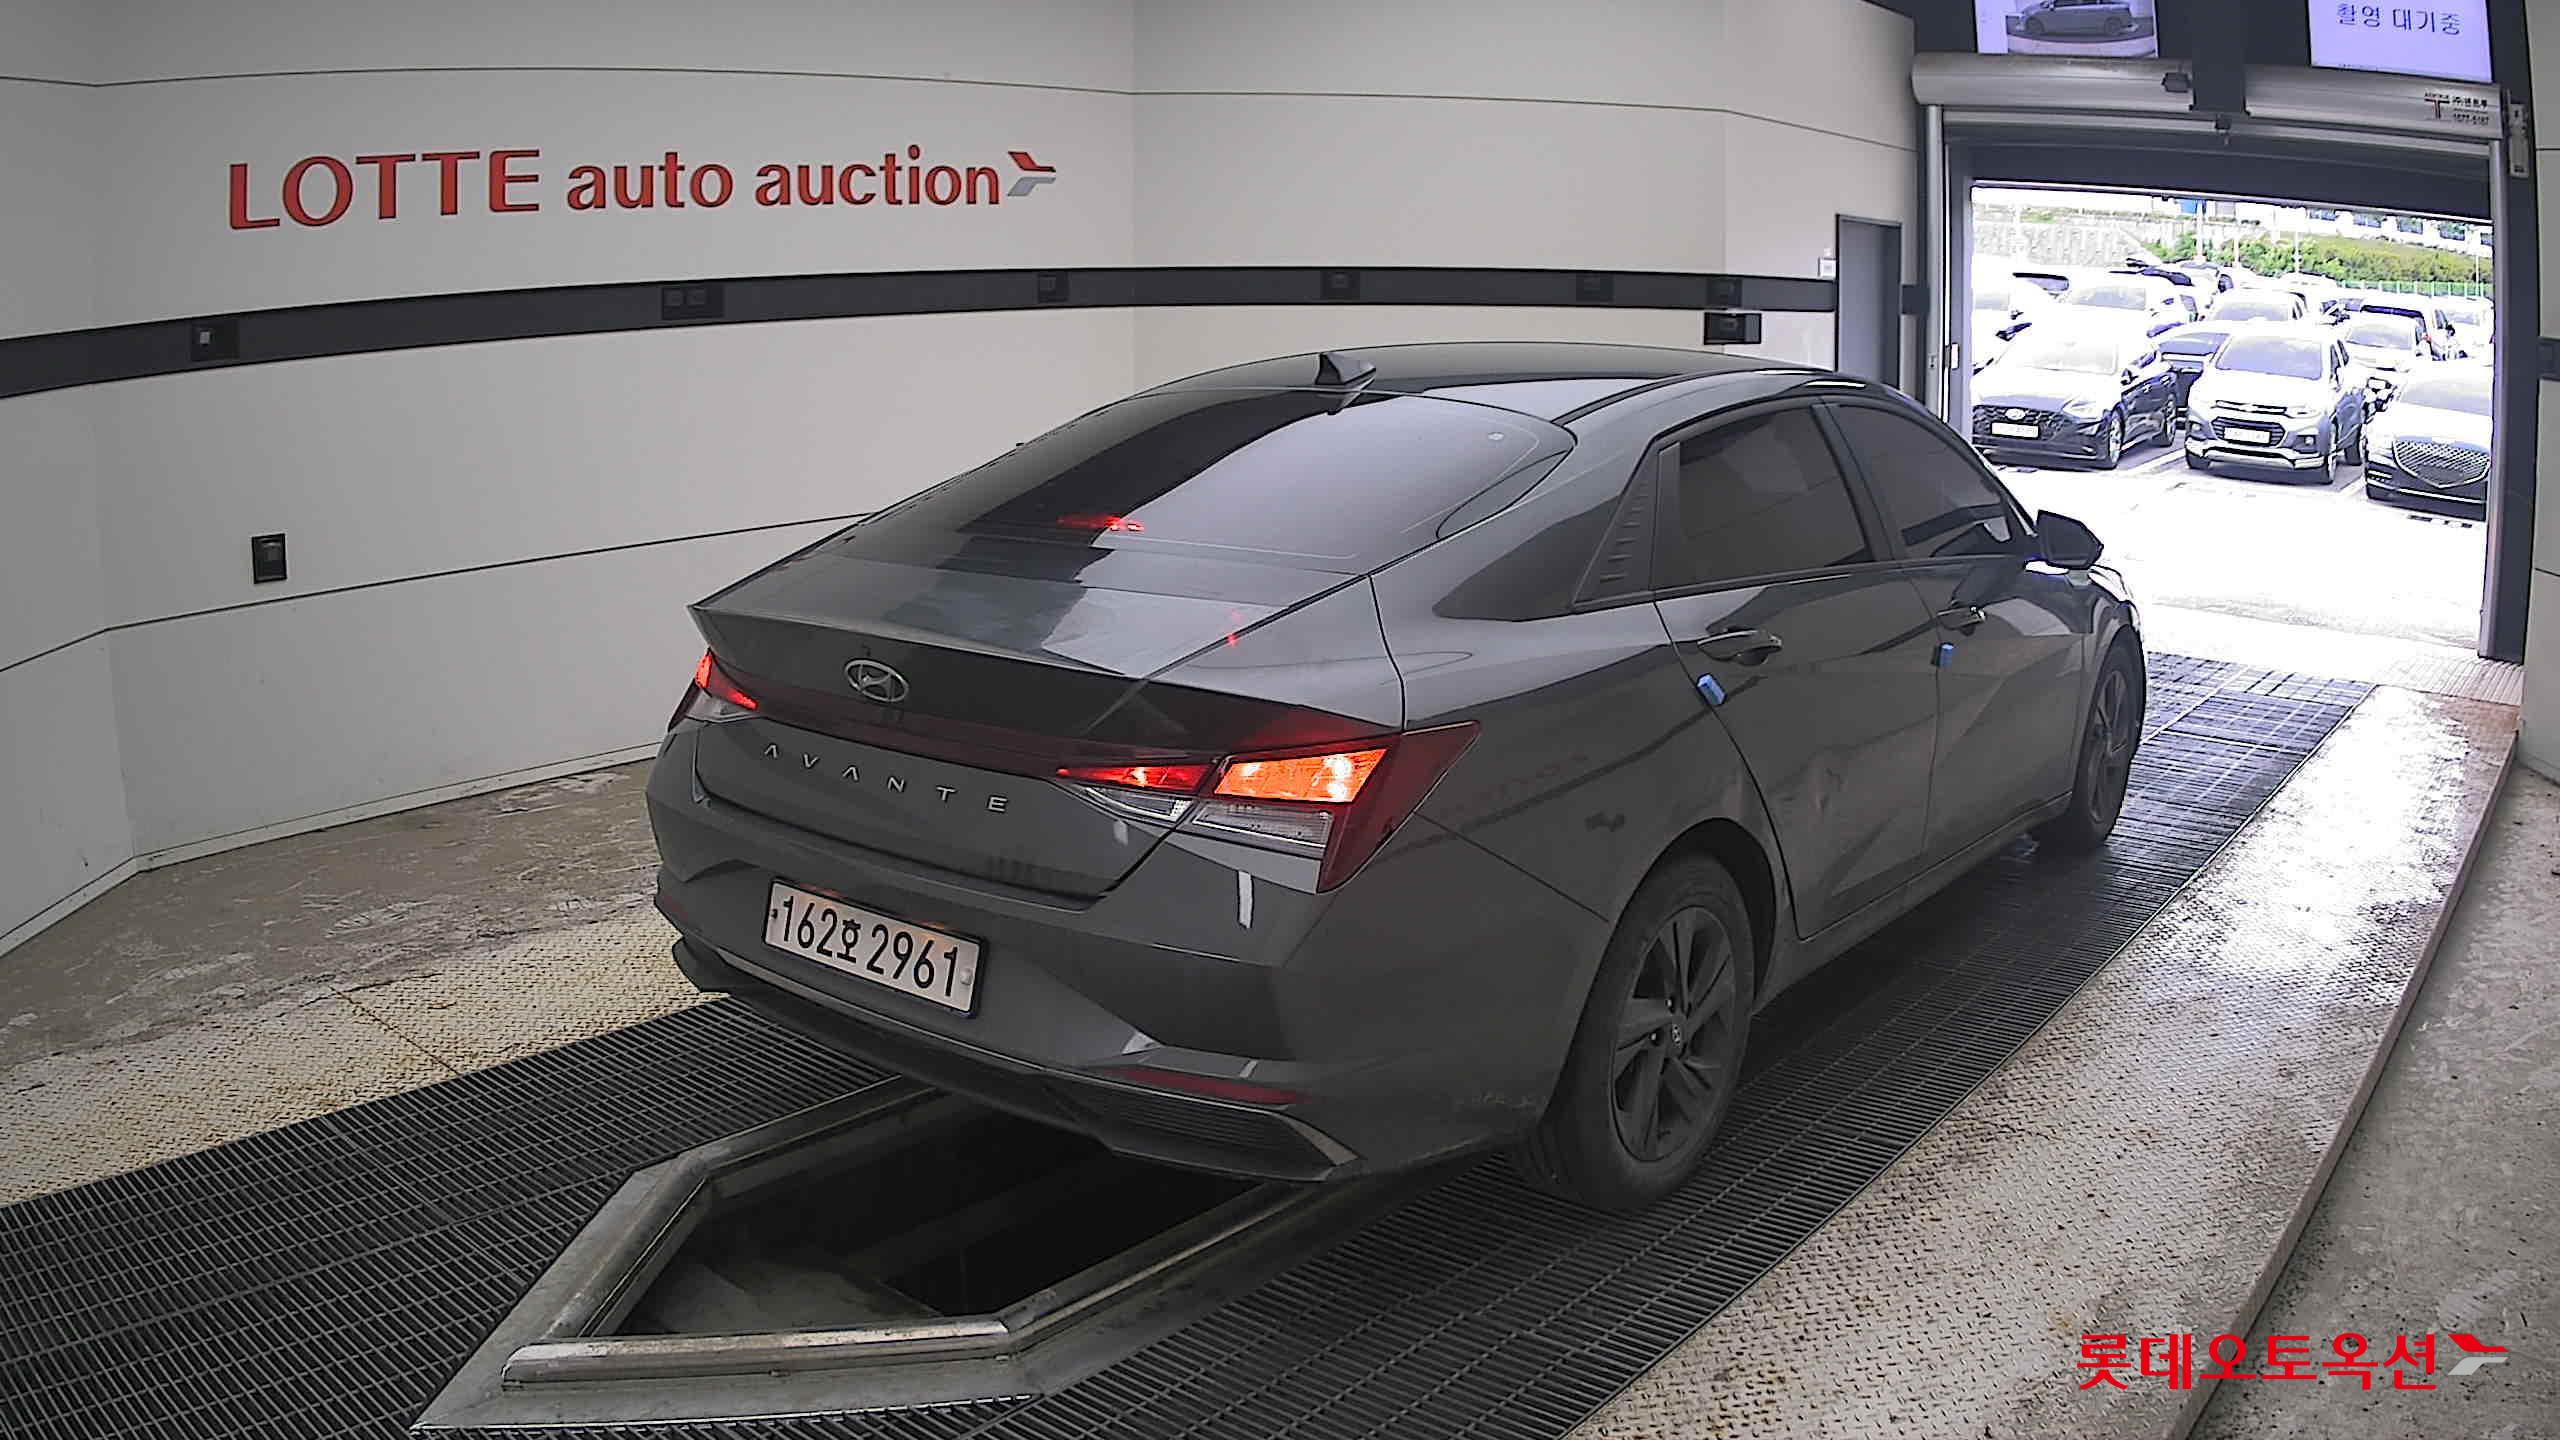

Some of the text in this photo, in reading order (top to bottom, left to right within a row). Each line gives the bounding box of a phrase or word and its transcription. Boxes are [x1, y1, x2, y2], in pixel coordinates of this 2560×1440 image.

[2337, 3, 2461, 36] 촬영 대기중
[229, 144, 1000, 230] LOTTE auto auction
[764, 743, 1009, 813] AVANTE
[866, 923, 959, 997] 2961
